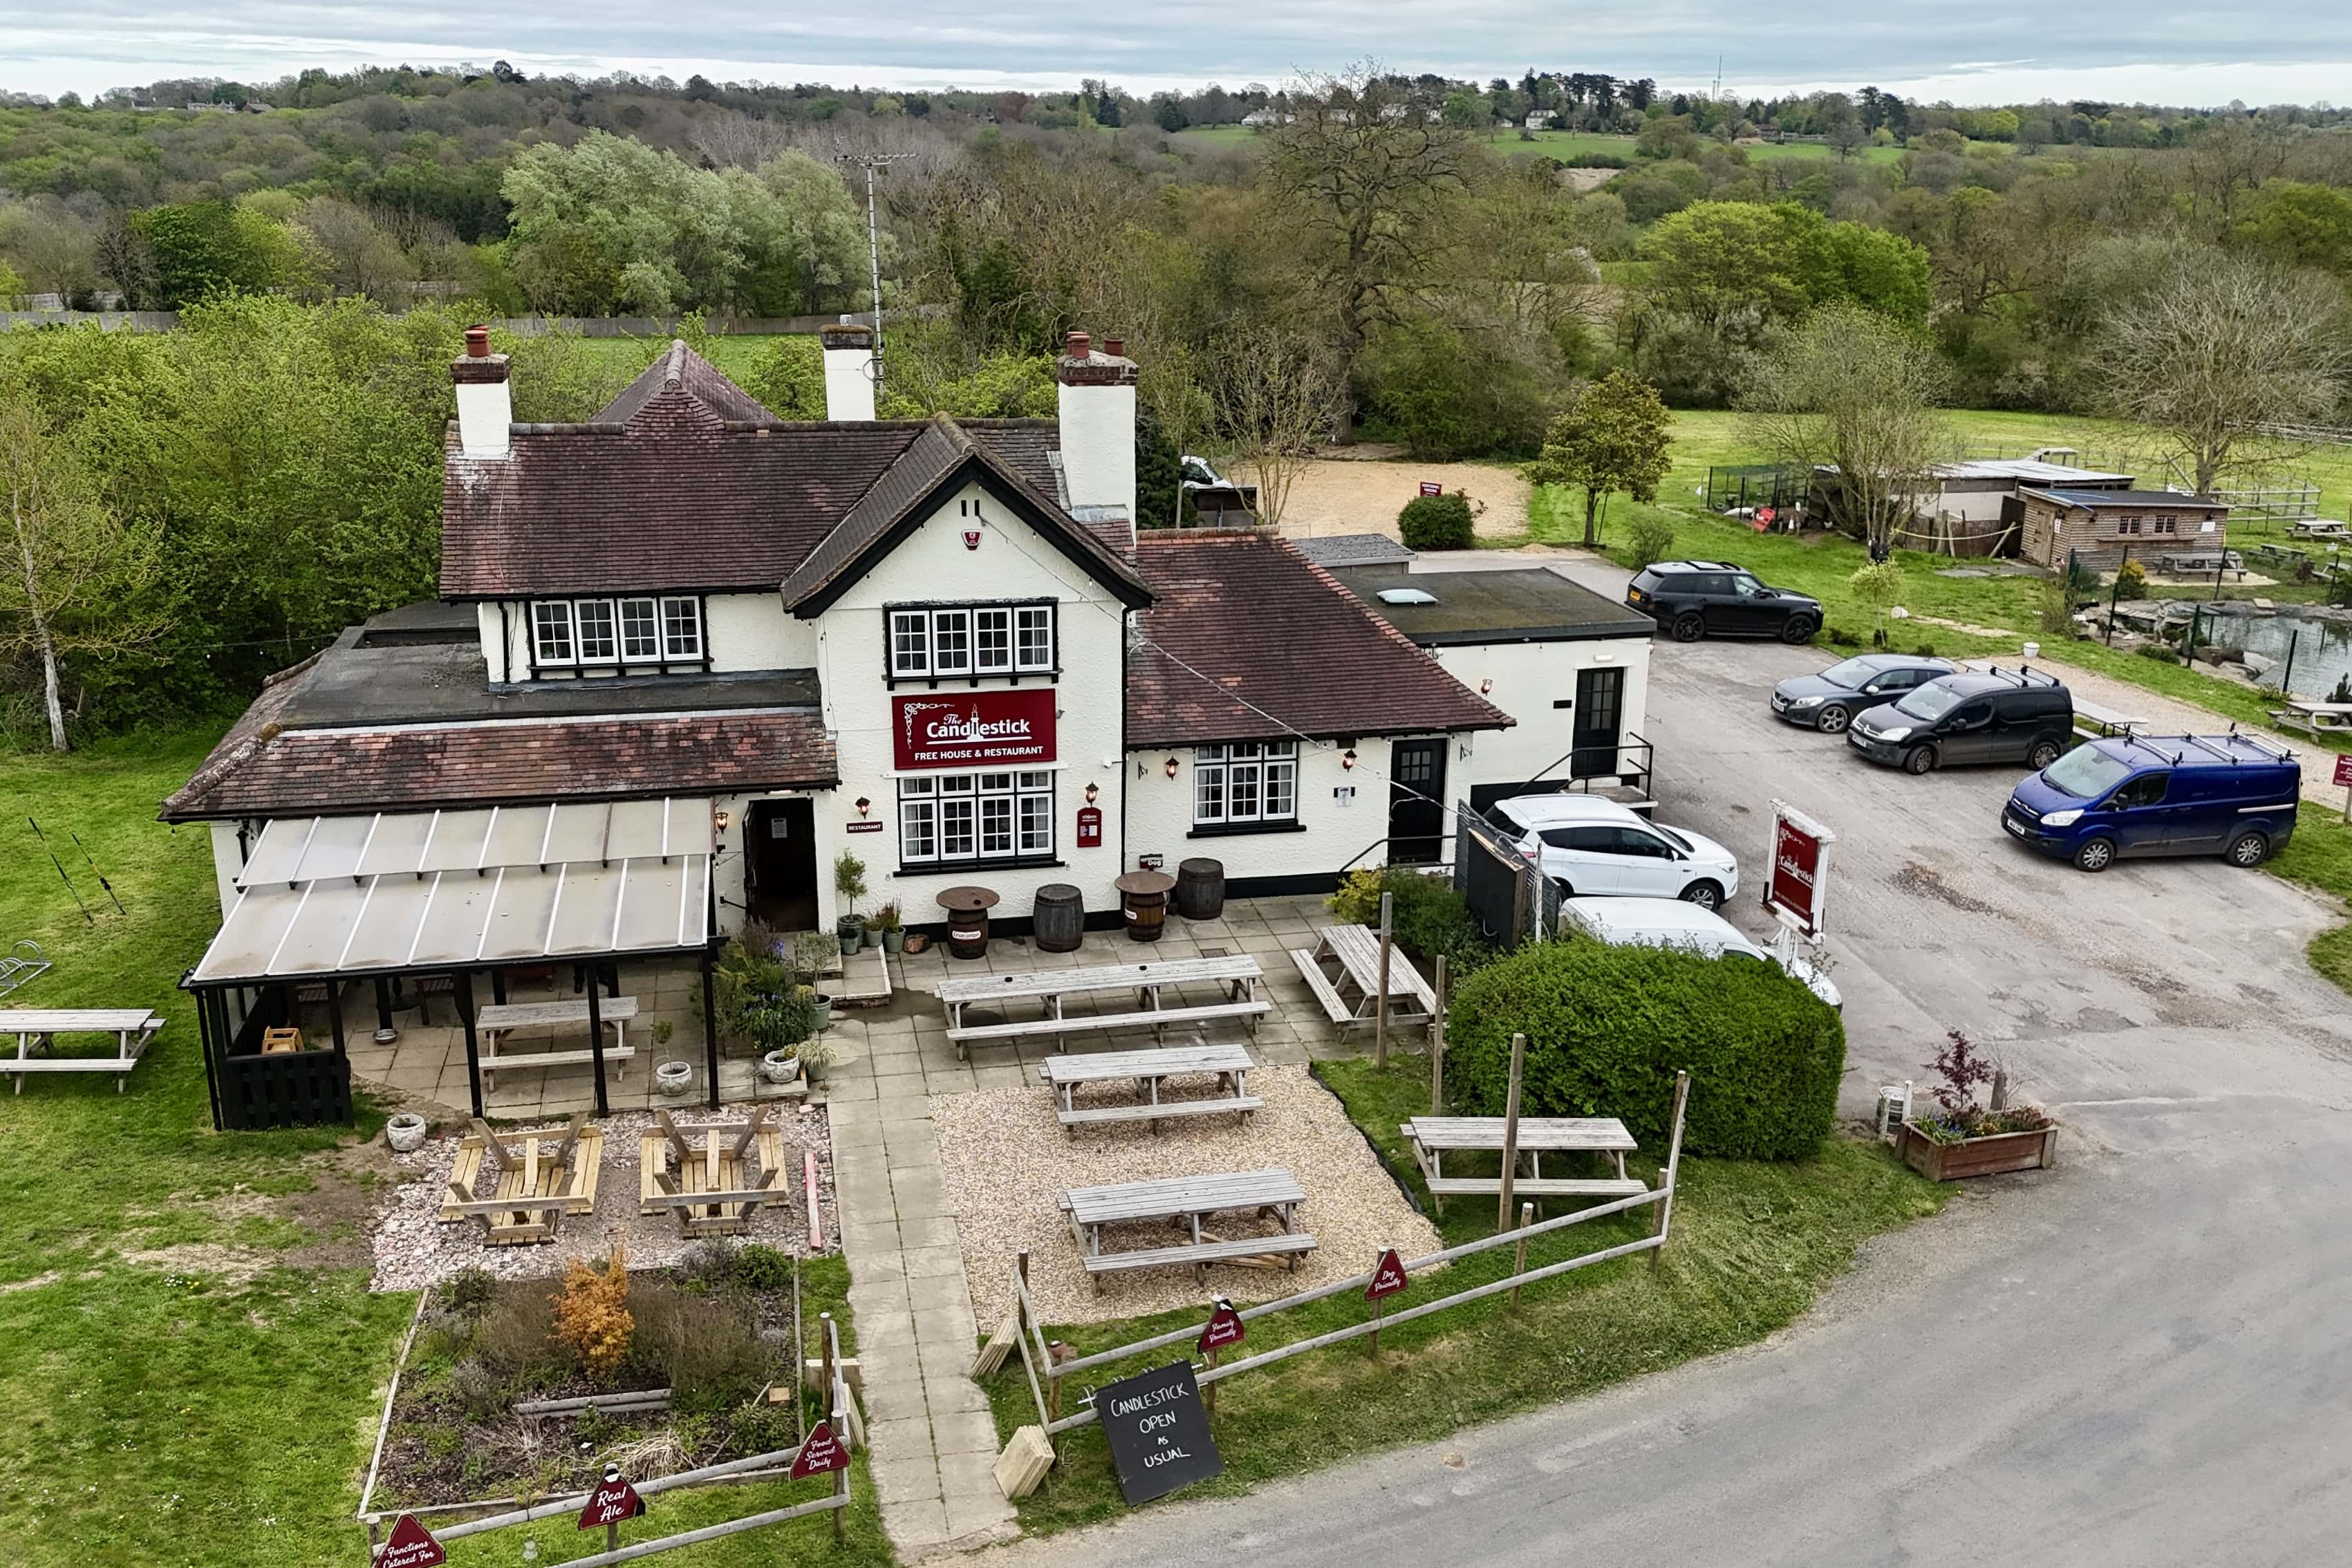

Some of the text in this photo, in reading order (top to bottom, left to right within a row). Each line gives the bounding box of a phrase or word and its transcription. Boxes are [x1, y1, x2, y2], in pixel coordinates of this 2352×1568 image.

[926, 717, 1030, 738] Candlestick
[943, 713, 962, 725] The
[915, 746, 1043, 760] FREE HOUSE & RESTAURANT
[1780, 855, 1813, 884] Candlestick
[1382, 1270, 1395, 1280] Dog
[1110, 1382, 1189, 1417] CANDLESTICK
[1139, 1410, 1177, 1433] OPEN
[811, 1437, 832, 1450] Food
[1157, 1435, 1168, 1445] AS
[805, 1446, 837, 1462] Served
[1144, 1446, 1191, 1467] USUAL
[808, 1457, 831, 1470] Daily
[597, 1486, 627, 1507] Real
[599, 1504, 625, 1522] Ale
[387, 1540, 429, 1558] Functions
[383, 1550, 436, 1568] Catered For
